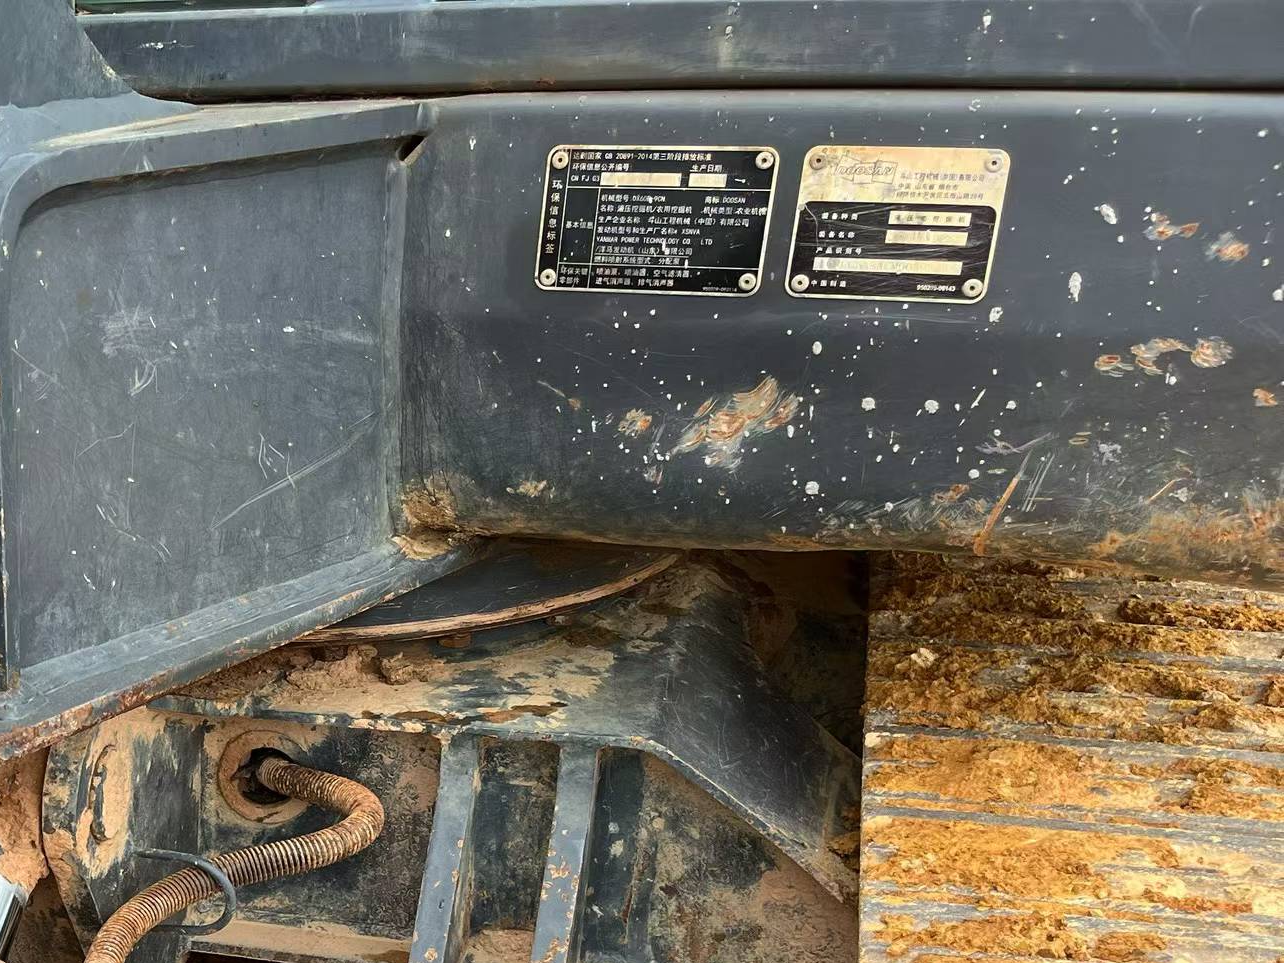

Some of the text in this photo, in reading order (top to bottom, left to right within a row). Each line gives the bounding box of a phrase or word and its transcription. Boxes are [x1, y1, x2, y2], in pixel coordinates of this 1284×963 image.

[691, 164, 723, 173] 生产日期
[836, 166, 894, 176] DOOSAN
[545, 180, 563, 254] 环保信息标签
